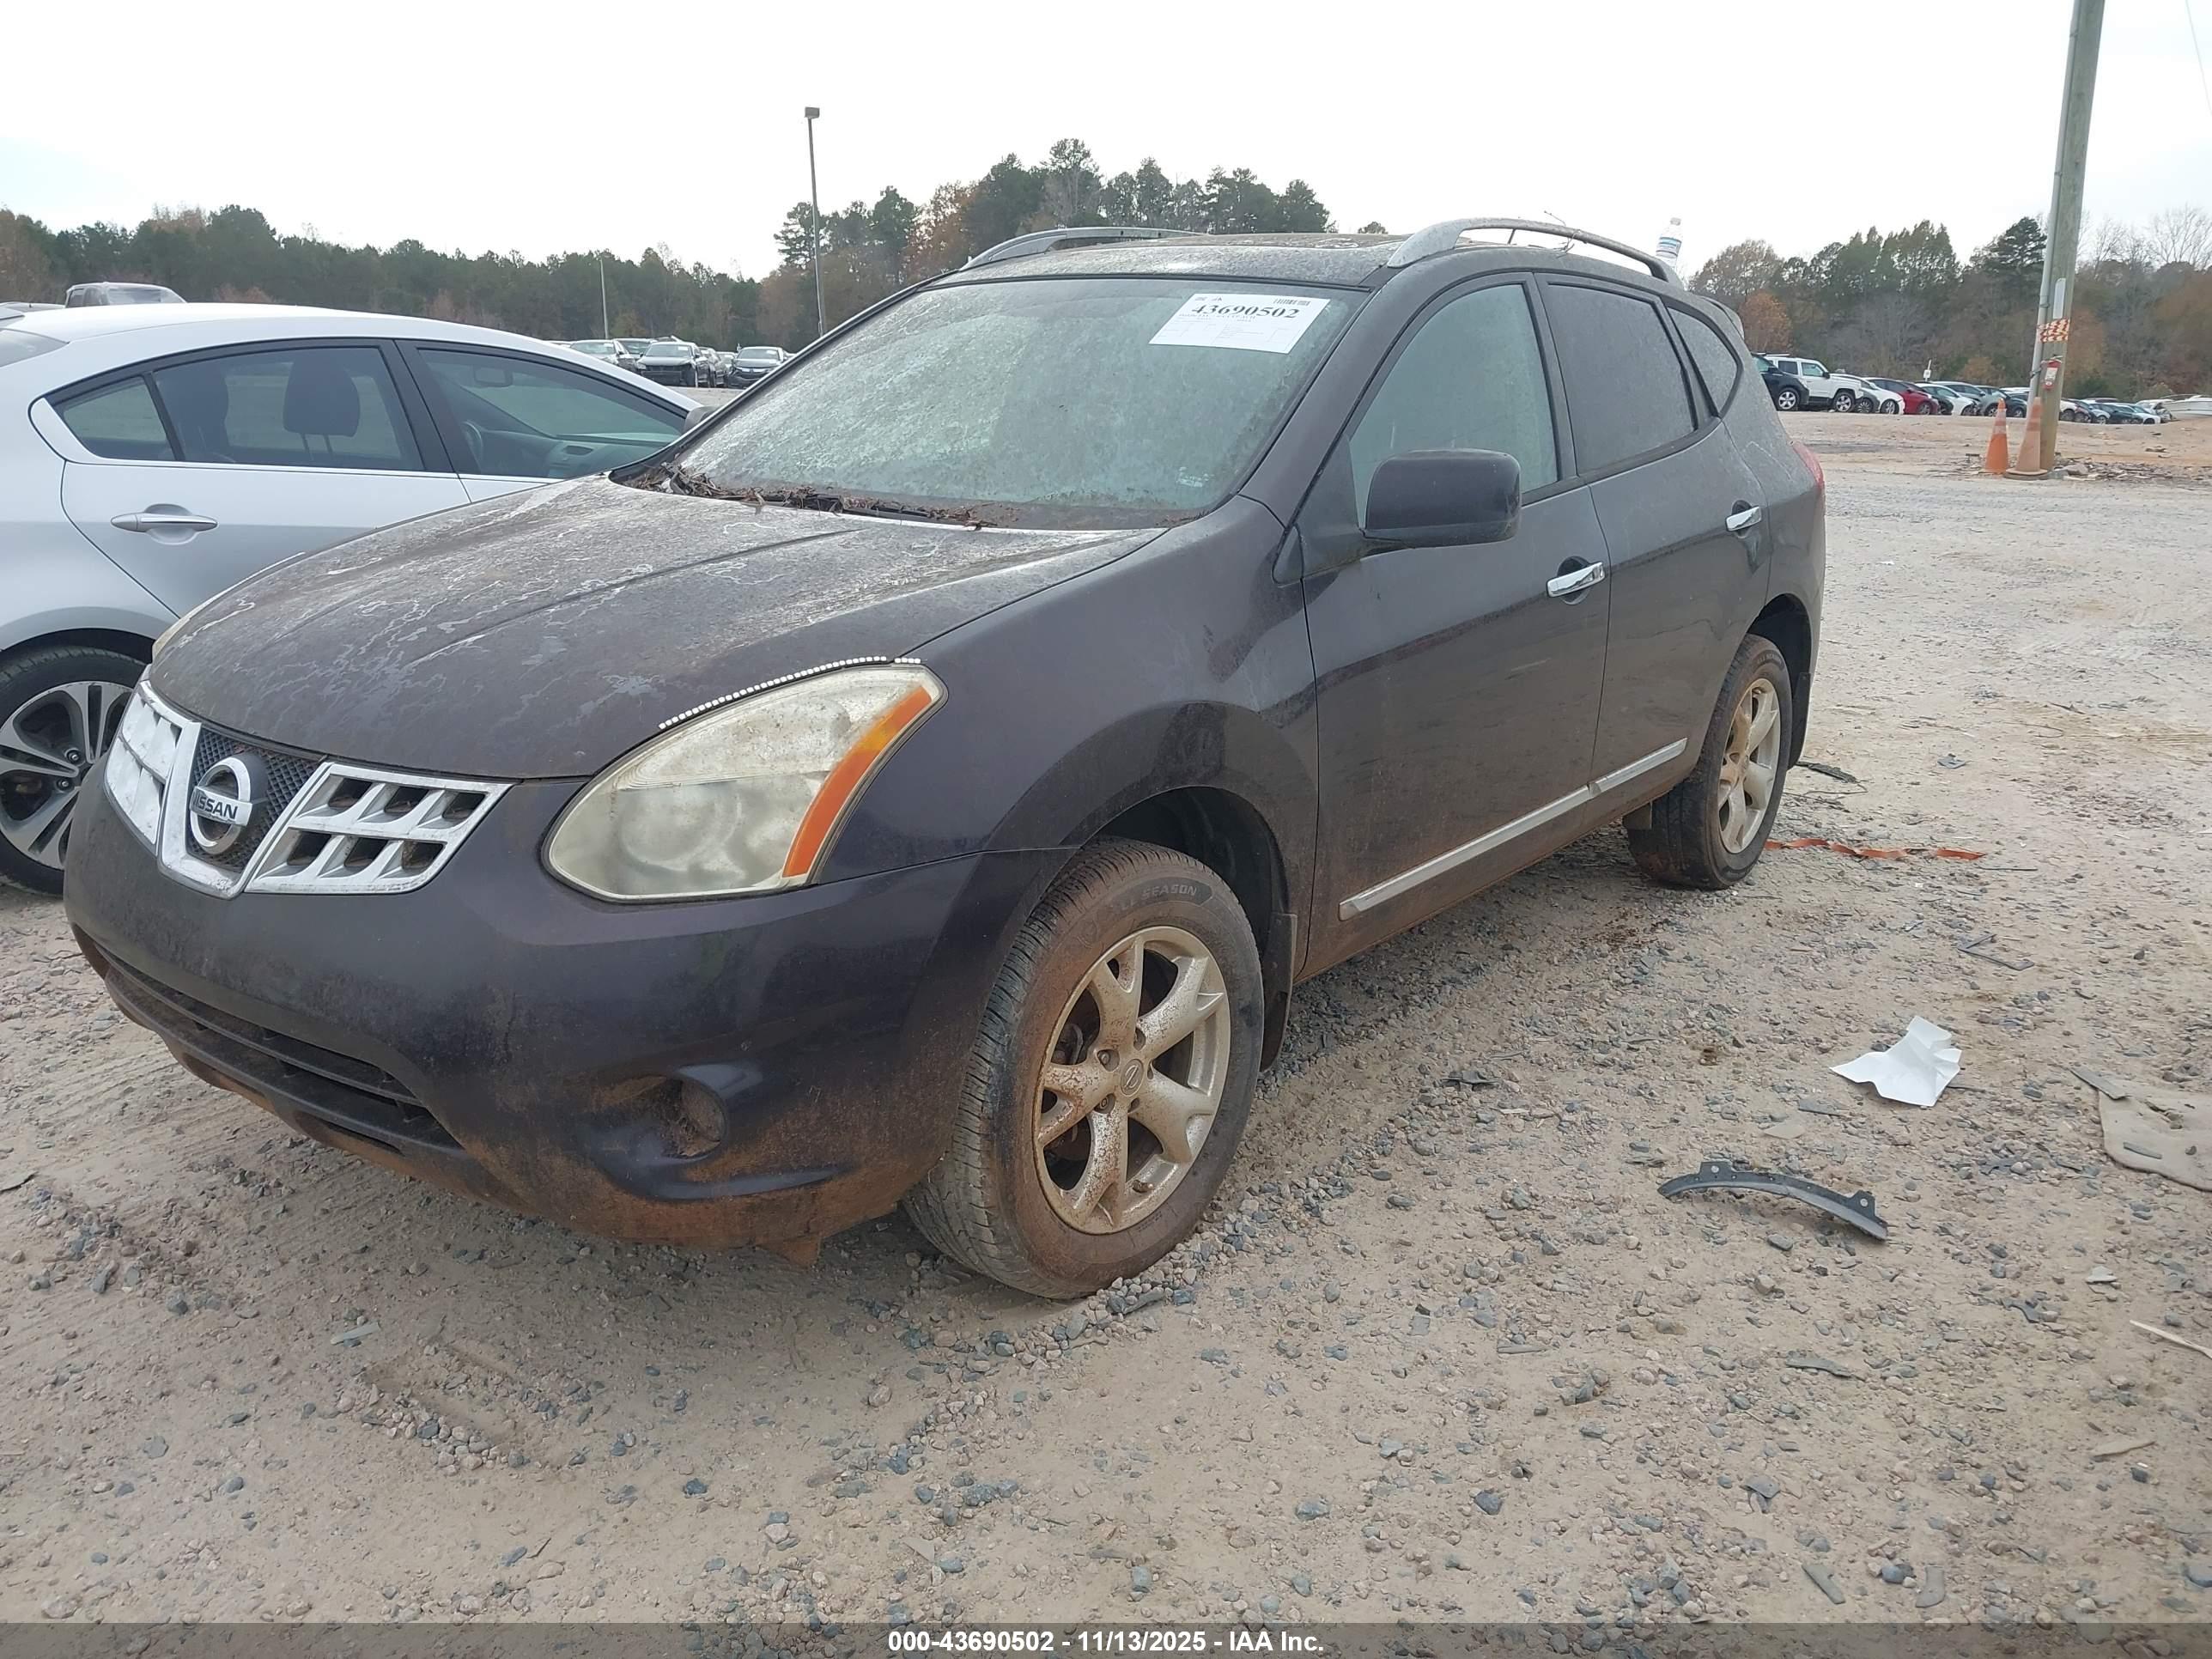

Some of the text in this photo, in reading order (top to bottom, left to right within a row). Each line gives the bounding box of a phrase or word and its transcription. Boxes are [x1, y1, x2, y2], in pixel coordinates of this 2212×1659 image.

[1191, 304, 1300, 319] 43690502
[192, 793, 238, 819] NISSAN
[1141, 884, 1197, 899] SEASON
